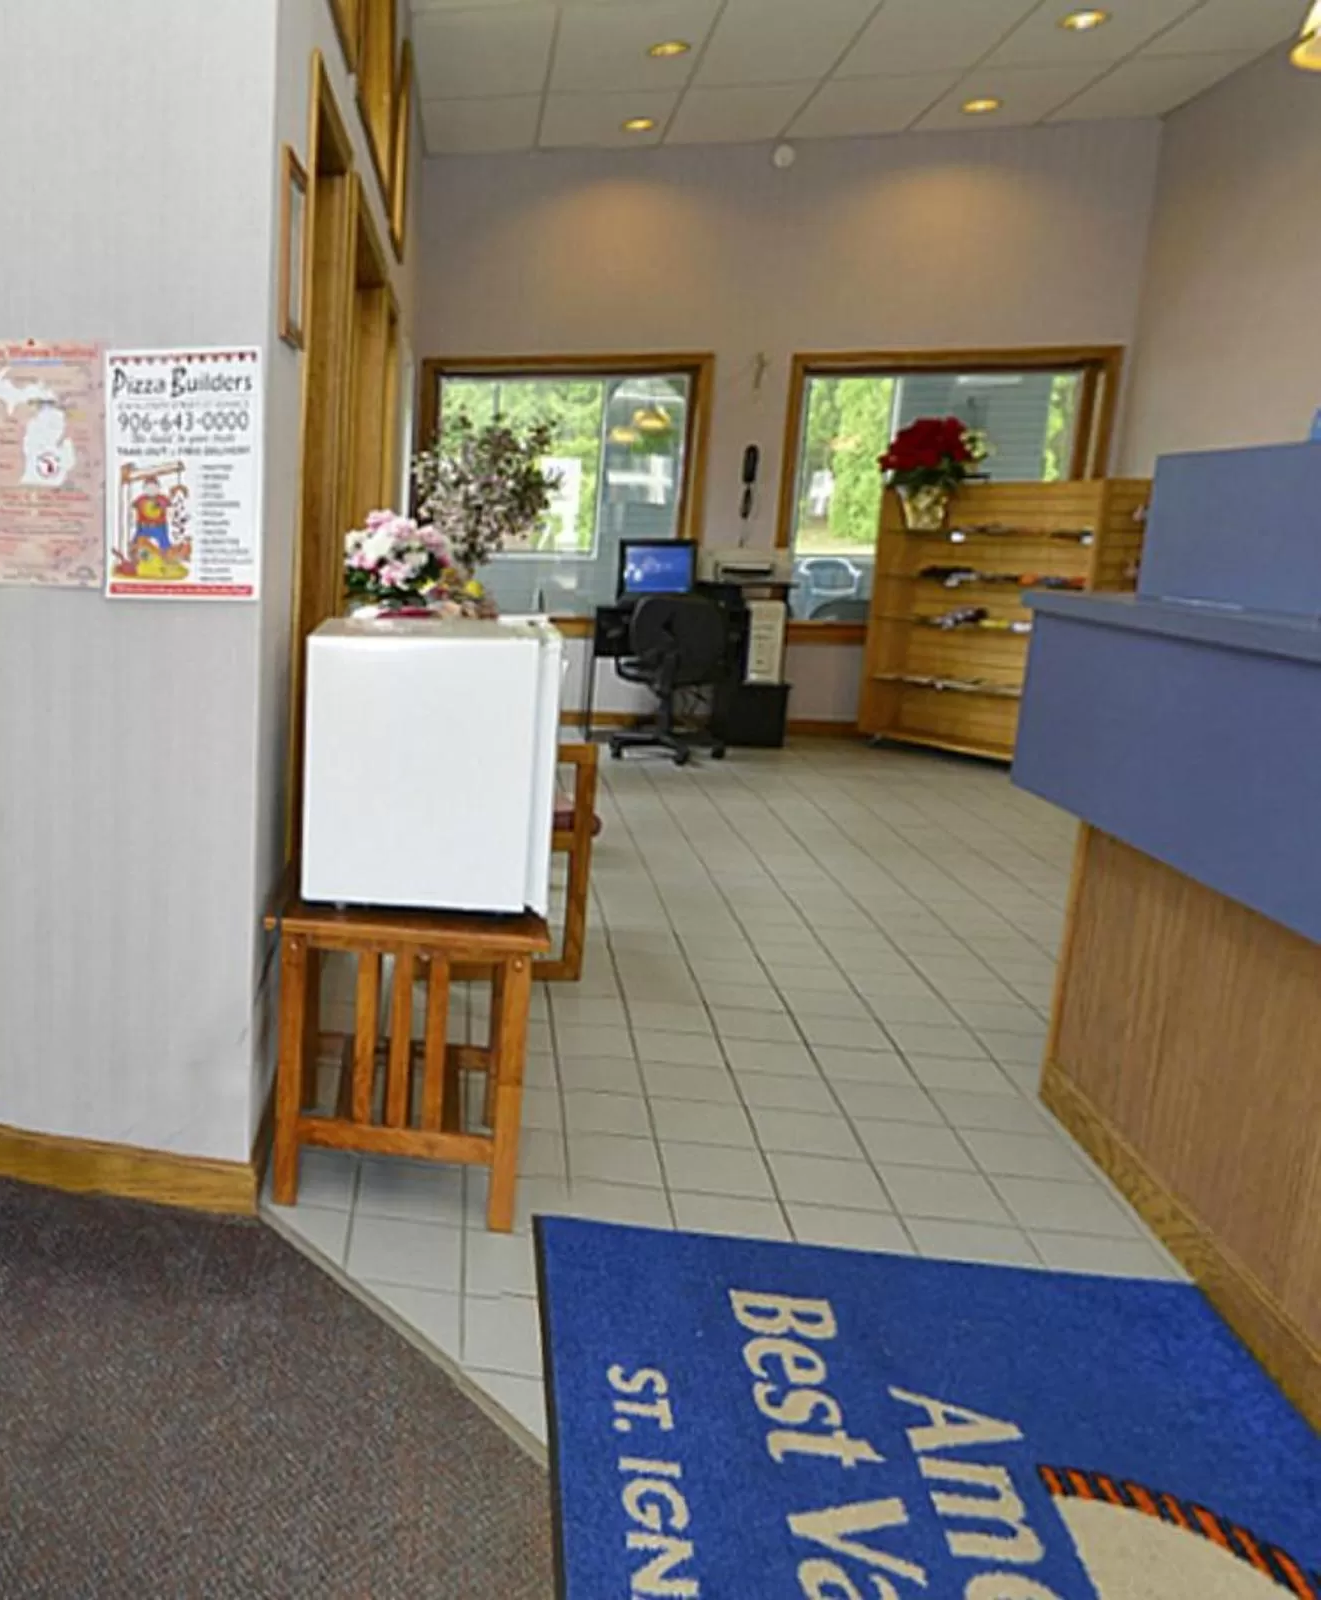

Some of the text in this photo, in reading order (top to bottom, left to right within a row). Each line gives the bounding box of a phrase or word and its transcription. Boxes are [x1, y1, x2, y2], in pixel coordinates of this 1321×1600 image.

[112, 366, 253, 398] Pizza Builders
[117, 411, 249, 431] 906-643-0000
[729, 1289, 884, 1467] Best
[607, 1364, 700, 1600] ST. IGN
